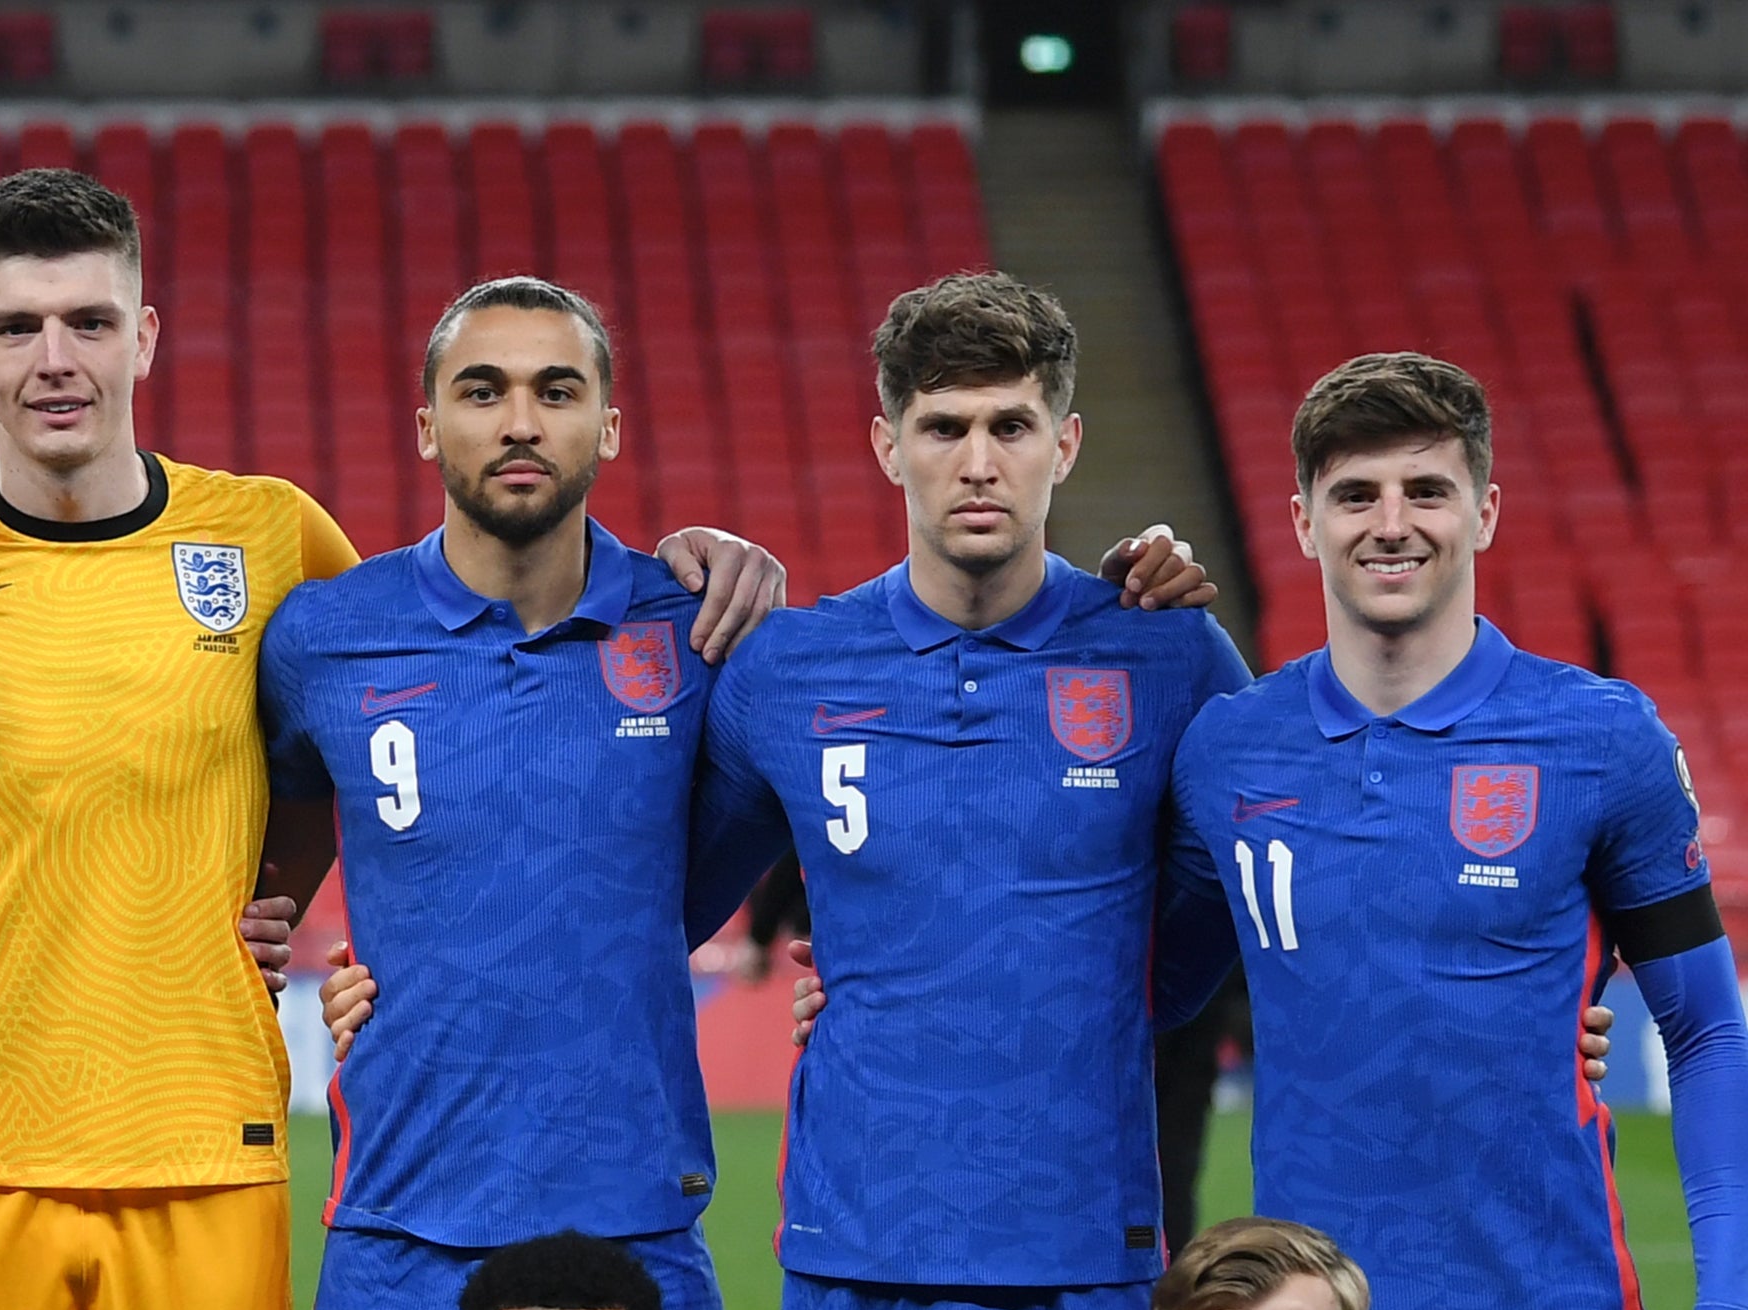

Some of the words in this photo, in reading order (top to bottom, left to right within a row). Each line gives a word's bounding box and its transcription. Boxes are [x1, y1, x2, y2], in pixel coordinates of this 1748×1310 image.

[369, 720, 421, 831] 9
[822, 744, 869, 855] 5
[1235, 839, 1299, 951] 11
